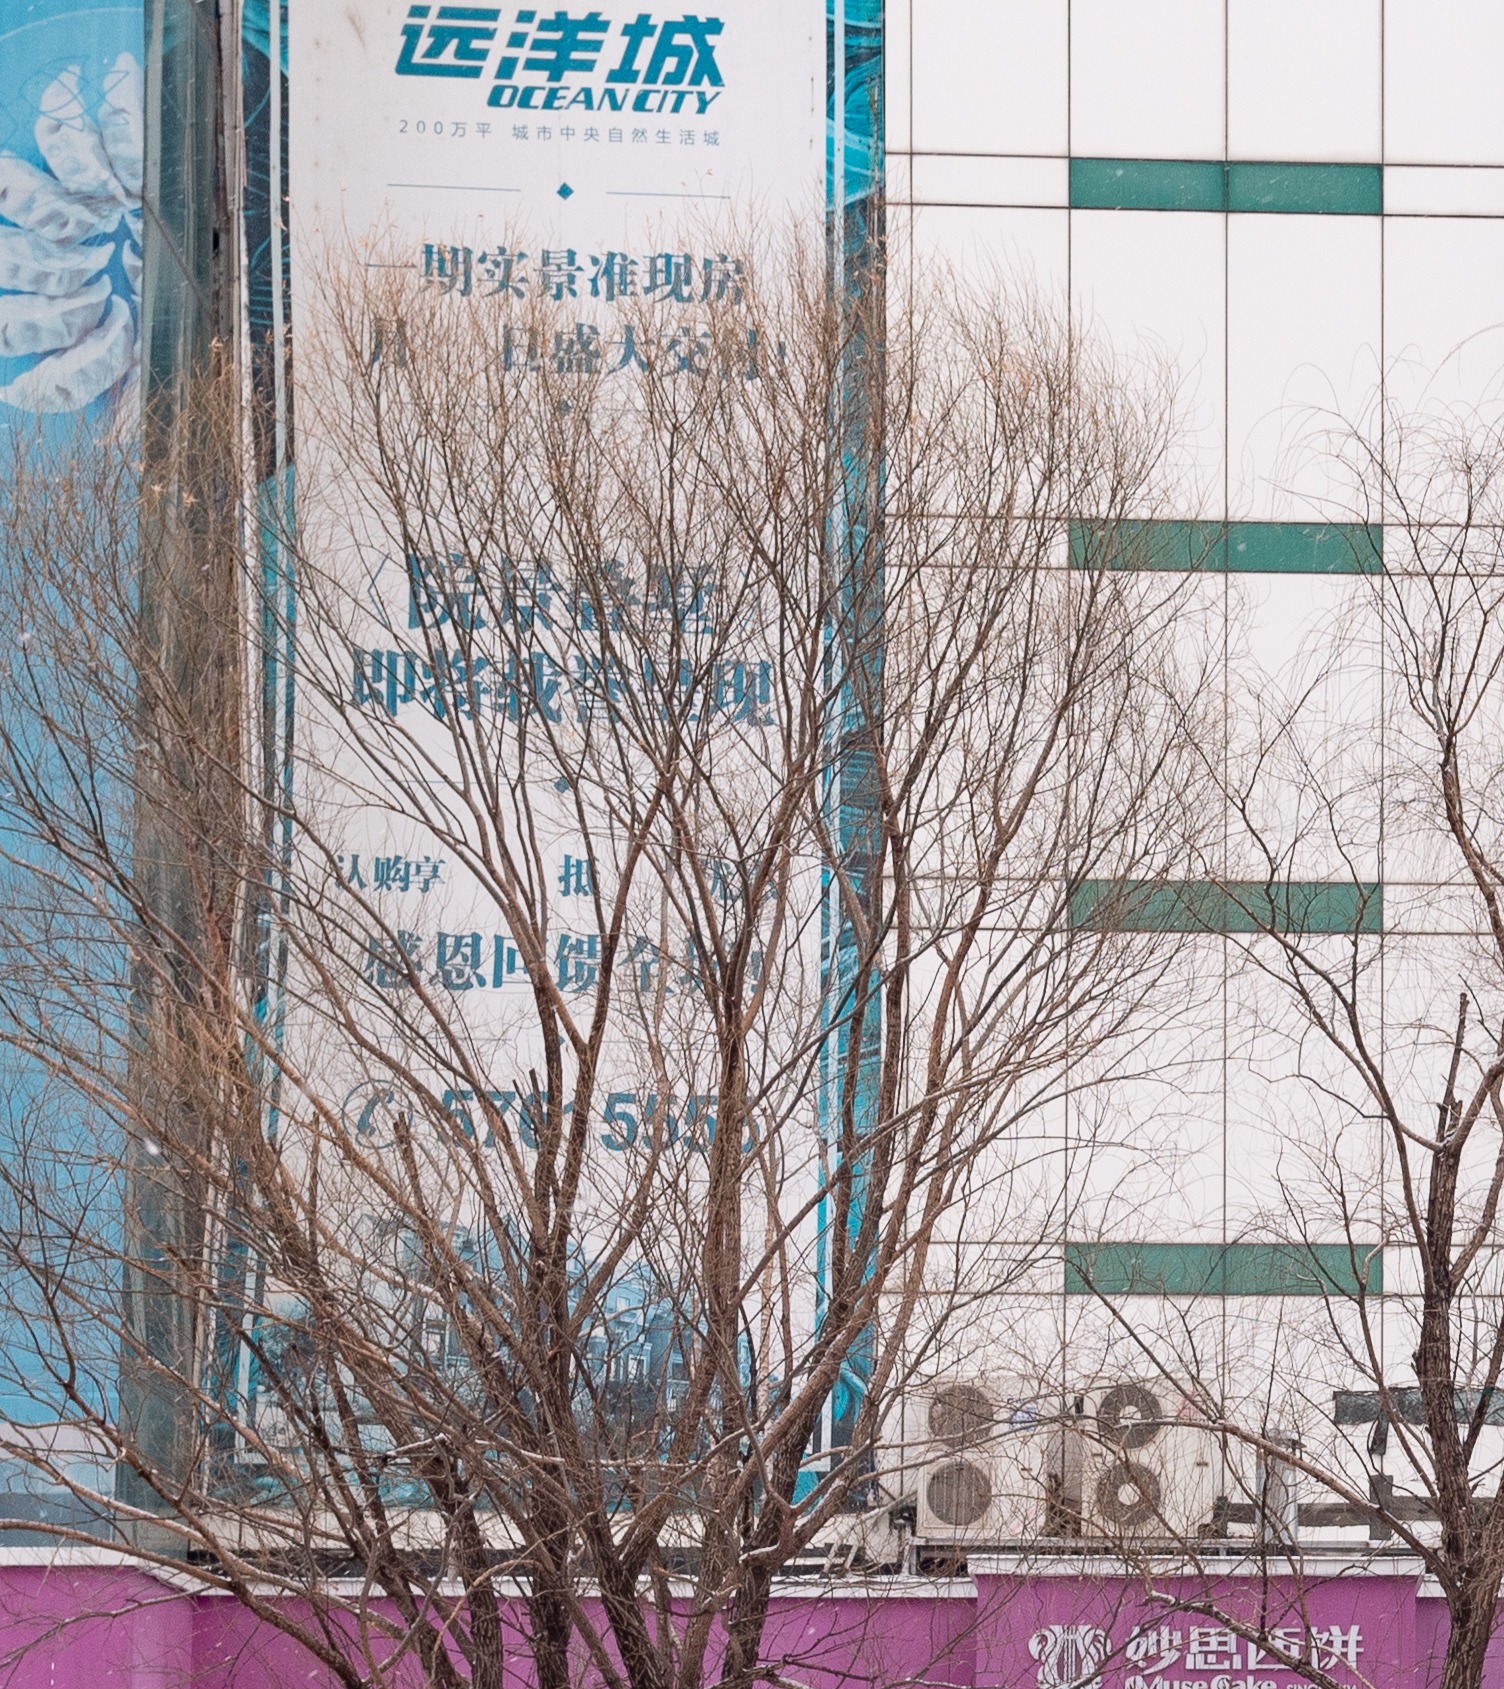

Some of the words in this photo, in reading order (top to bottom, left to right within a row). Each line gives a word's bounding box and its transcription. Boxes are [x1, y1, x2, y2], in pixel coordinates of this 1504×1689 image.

[395, 4, 726, 87] 远洋城
[487, 84, 632, 111] OCEAN
[632, 90, 722, 115] CITY
[399, 119, 493, 140] 200万平
[512, 123, 722, 147] 城市中央自然生活城
[1124, 1624, 1365, 1675] 妙思西饼
